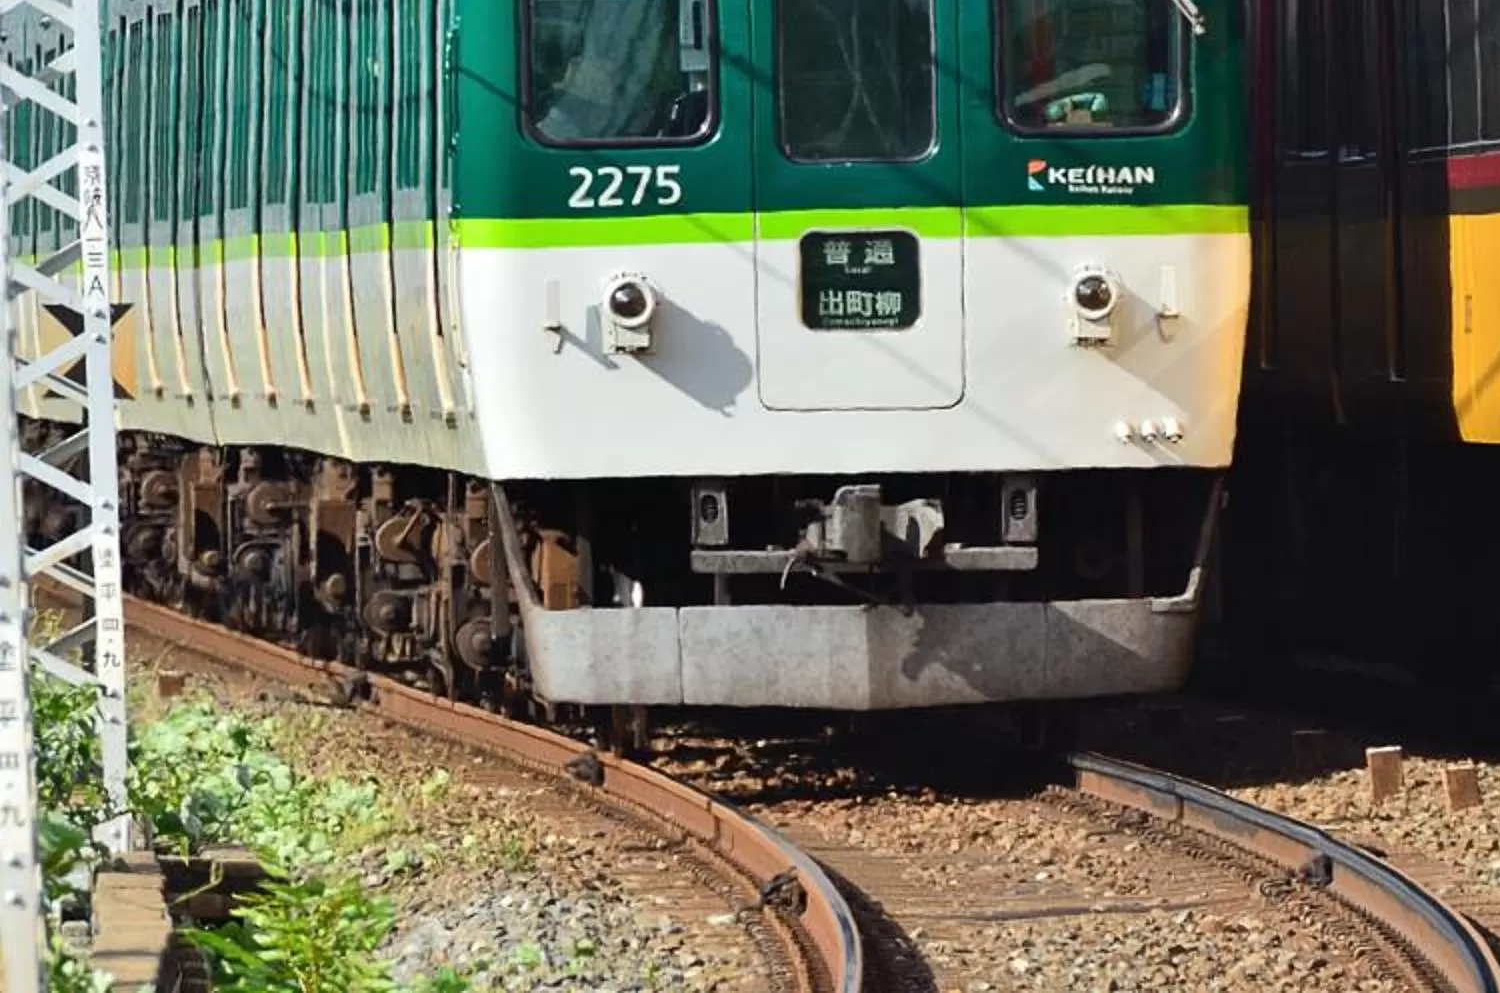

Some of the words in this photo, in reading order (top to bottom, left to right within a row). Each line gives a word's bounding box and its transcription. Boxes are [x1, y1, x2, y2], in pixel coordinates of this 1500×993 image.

[568, 165, 682, 208] 2275
[1048, 165, 1155, 185] KEIHAN
[819, 290, 902, 317] 出町柳
